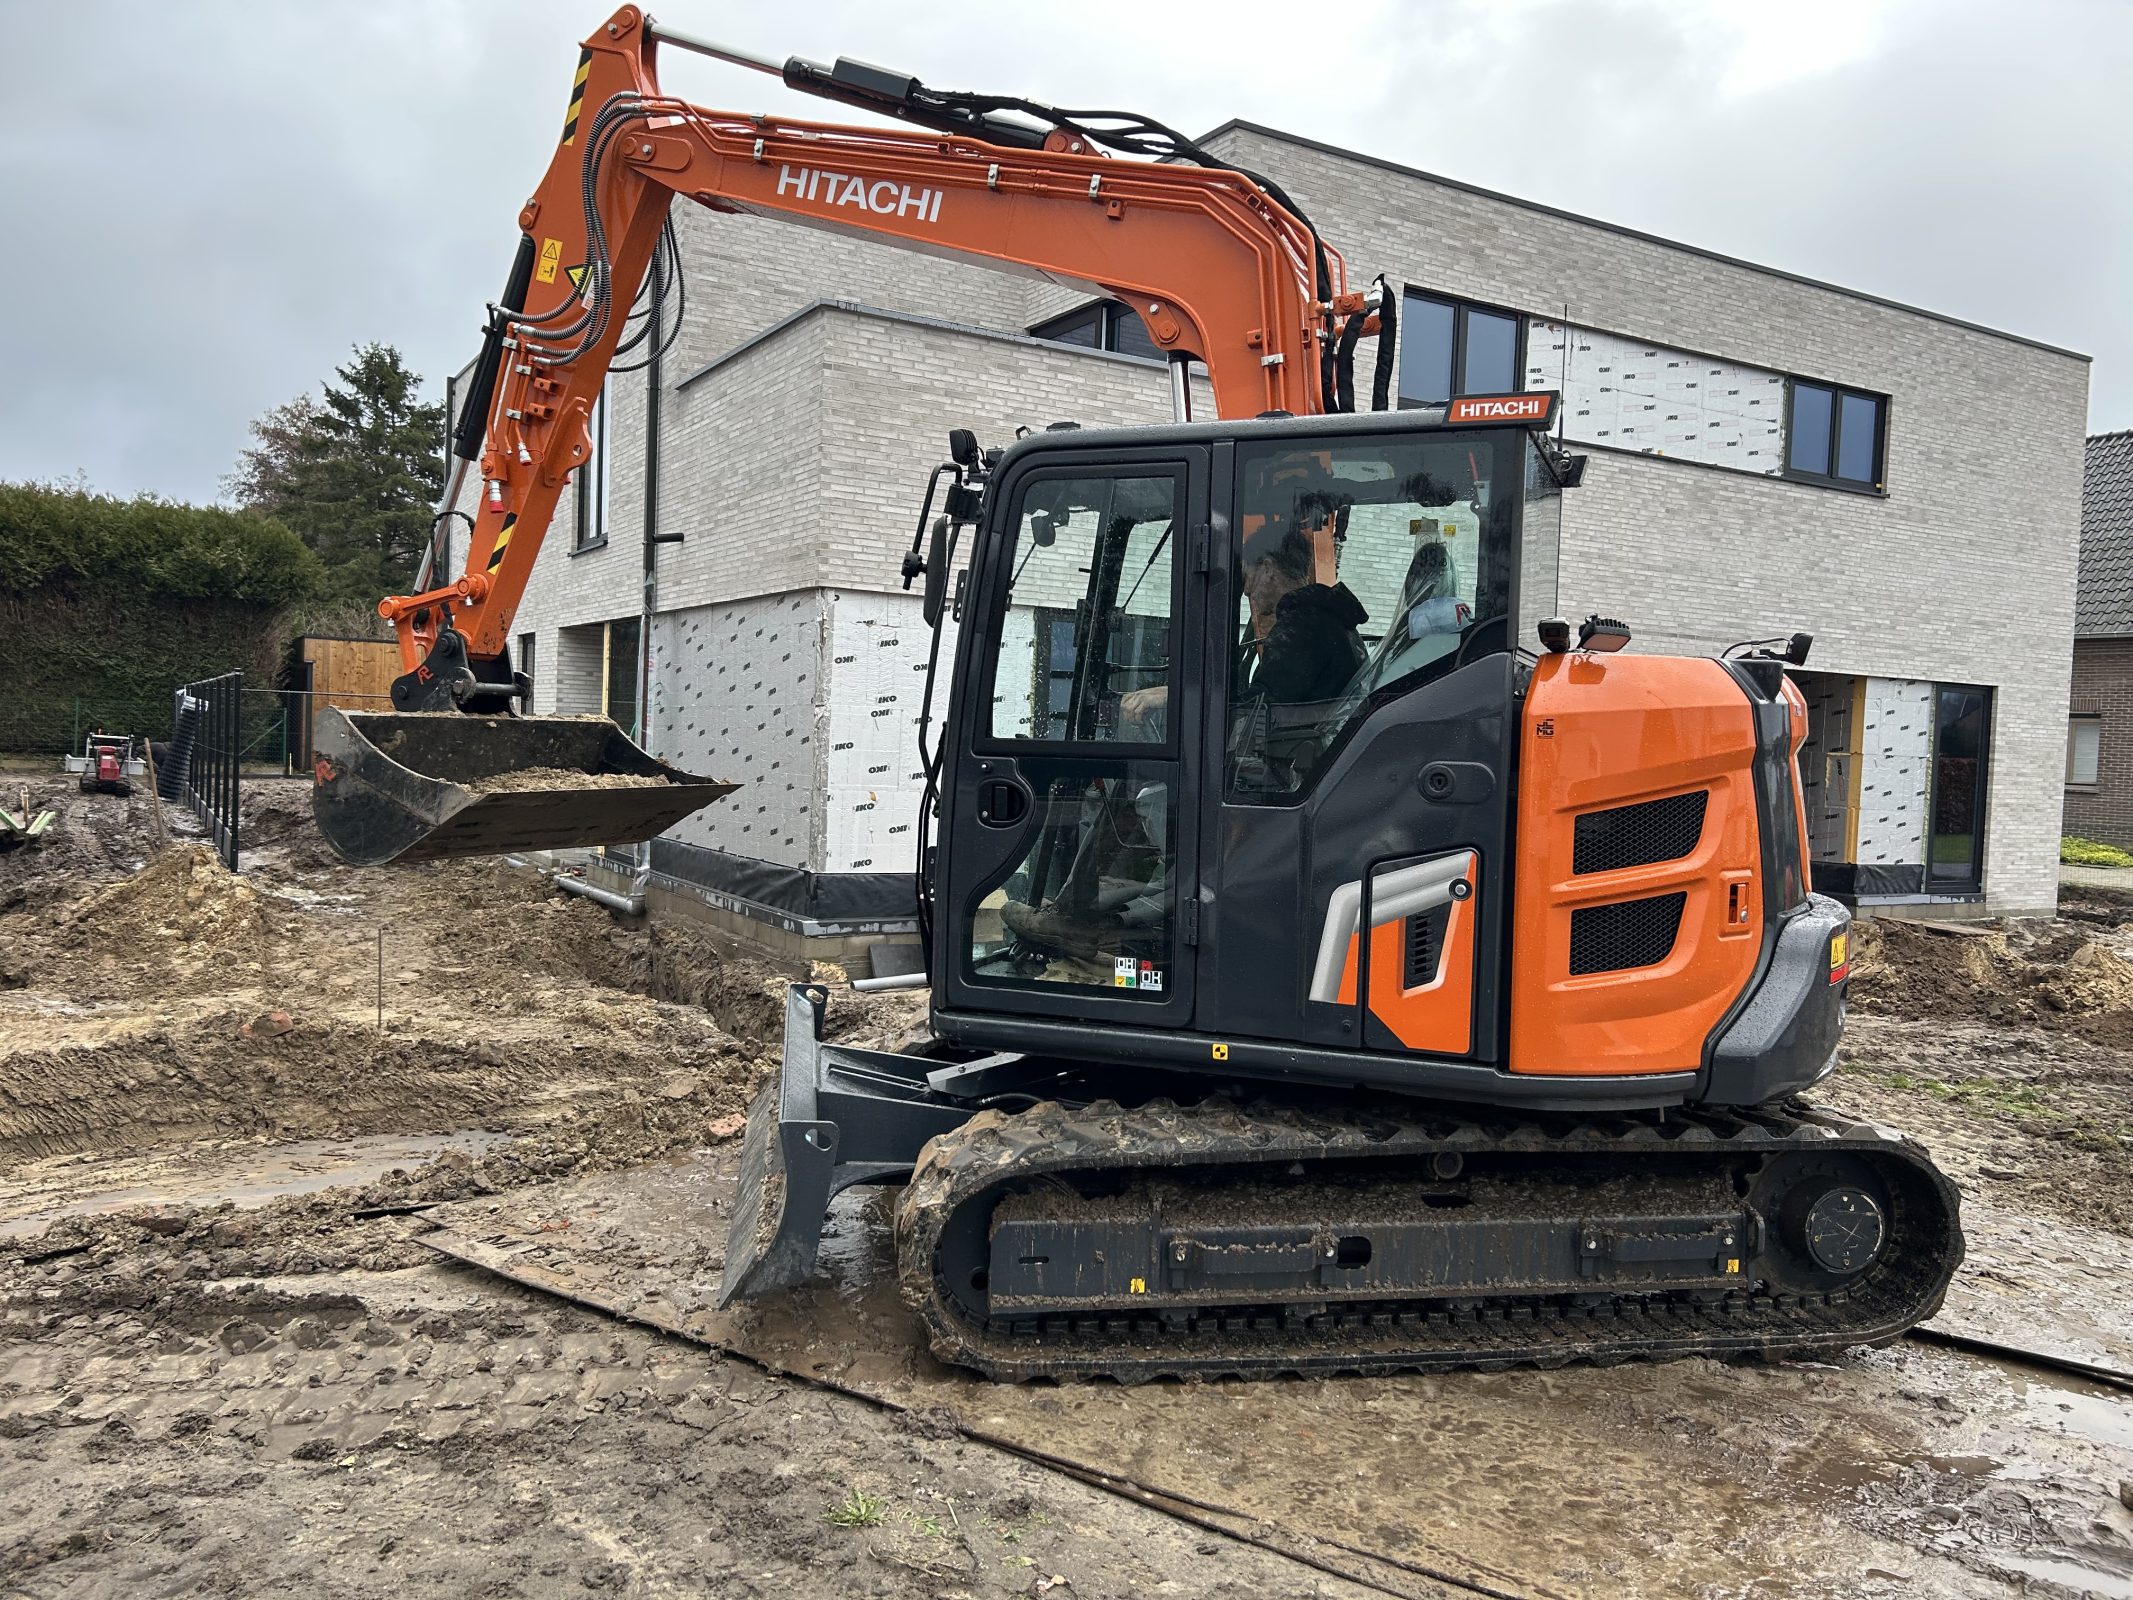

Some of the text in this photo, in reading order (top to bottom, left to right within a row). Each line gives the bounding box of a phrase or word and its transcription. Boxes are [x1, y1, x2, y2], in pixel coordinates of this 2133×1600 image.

[777, 165, 943, 223] HITACHI
[1460, 400, 1539, 417] HITACHI
[879, 640, 899, 648] IKO
[878, 696, 897, 704] IKO
[835, 742, 853, 750] IKO
[856, 803, 874, 811] IKO
[853, 859, 872, 868] IKO
